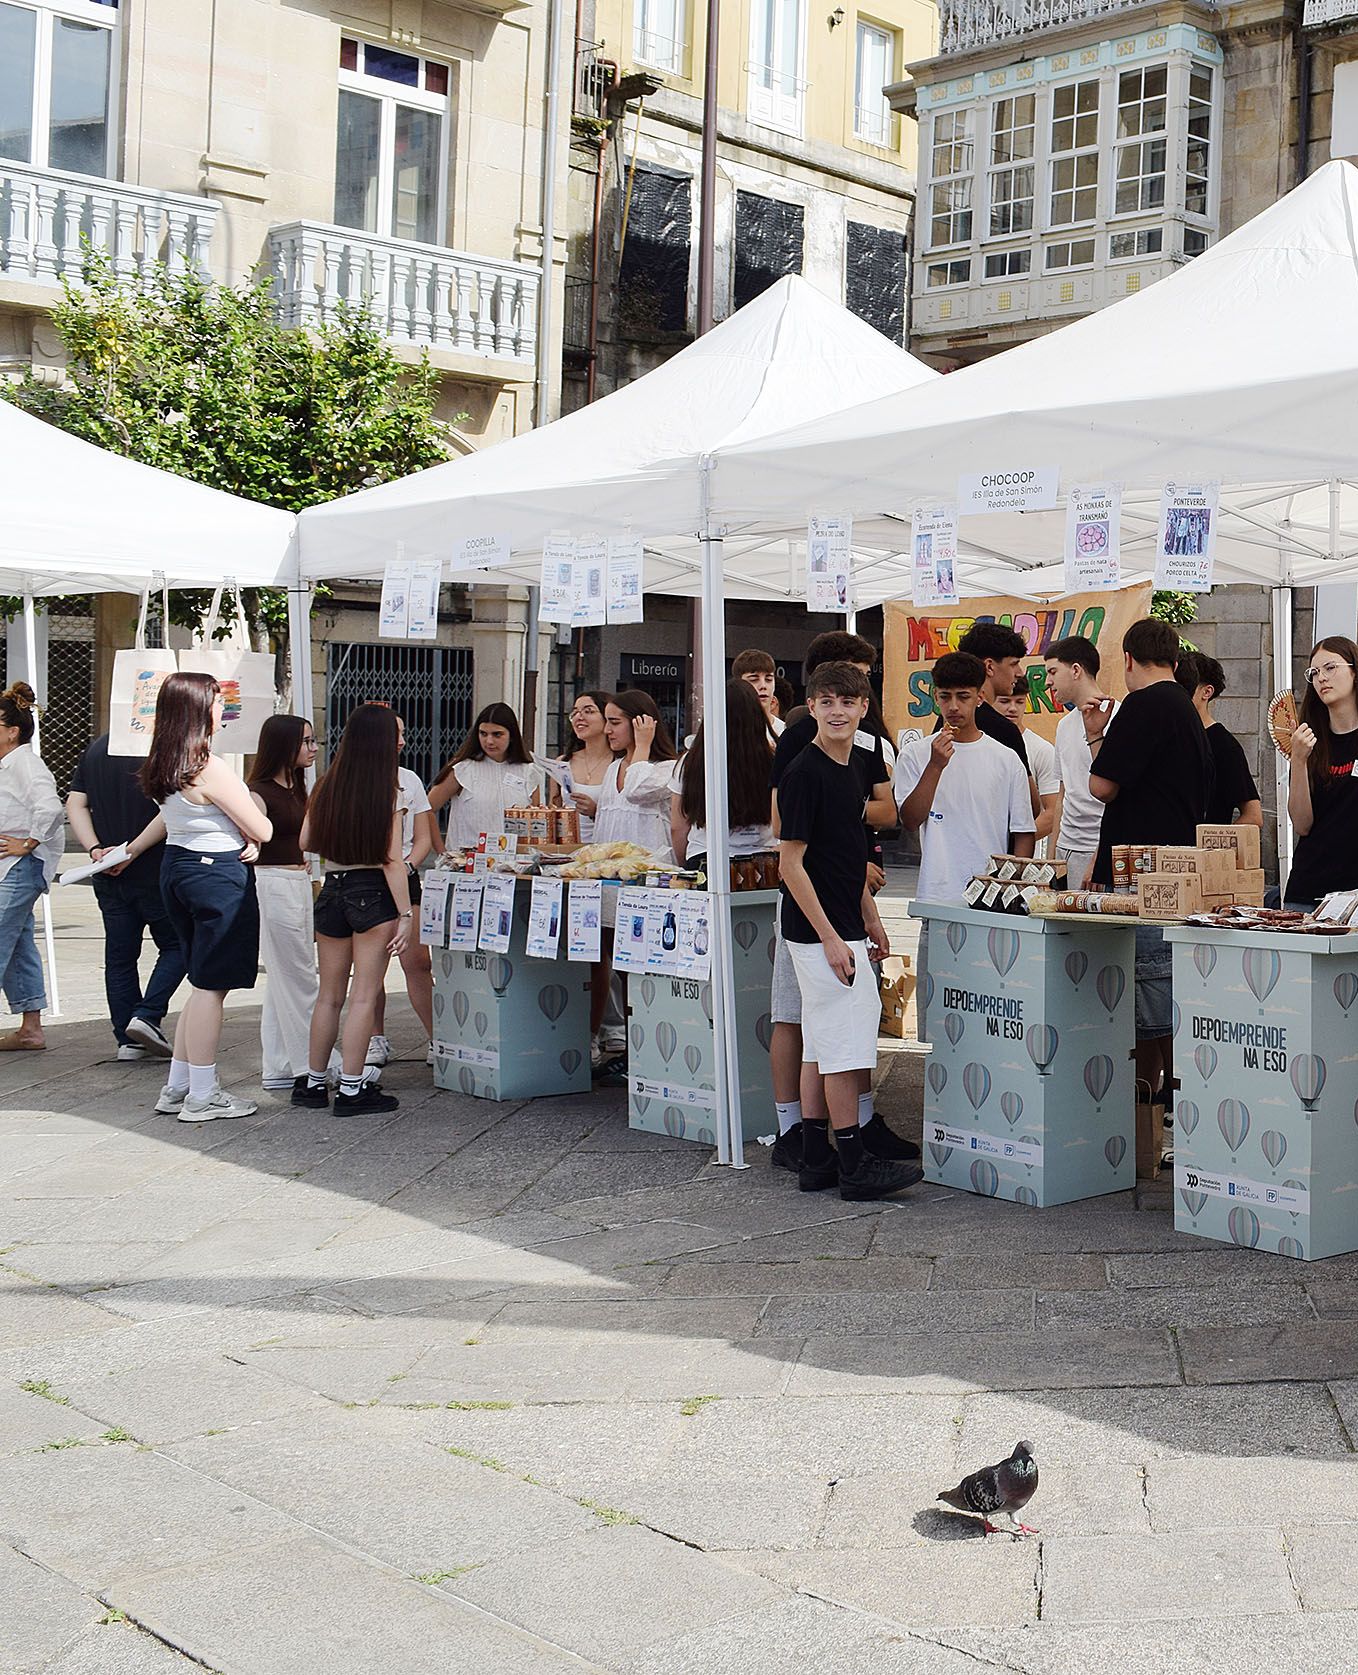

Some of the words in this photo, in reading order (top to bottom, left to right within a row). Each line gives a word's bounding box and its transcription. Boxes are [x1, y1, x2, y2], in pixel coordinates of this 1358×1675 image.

[981, 471, 1035, 487] CHOCOOP
[995, 488, 1004, 497] de
[1005, 487, 1019, 496] San
[1020, 484, 1042, 495] Simón
[987, 498, 1025, 509] Redondela
[1076, 503, 1083, 511] AS
[1105, 500, 1112, 508] DE
[1173, 497, 1206, 506] PONTEVERDE
[466, 536, 495, 549] COOPILLA
[631, 659, 678, 677] Librería
[465, 955, 473, 969] NA
[475, 956, 487, 971] ESO
[671, 981, 681, 998] NA
[684, 983, 699, 1000] ESO
[944, 987, 1023, 1020] DEPOEMPRENDE
[987, 1017, 999, 1037] NA
[1004, 1020, 1023, 1041] ESO
[1192, 1016, 1287, 1050] DEPOEMPRENDE
[1243, 1047, 1259, 1069] NA
[1264, 1050, 1287, 1073] ESO
